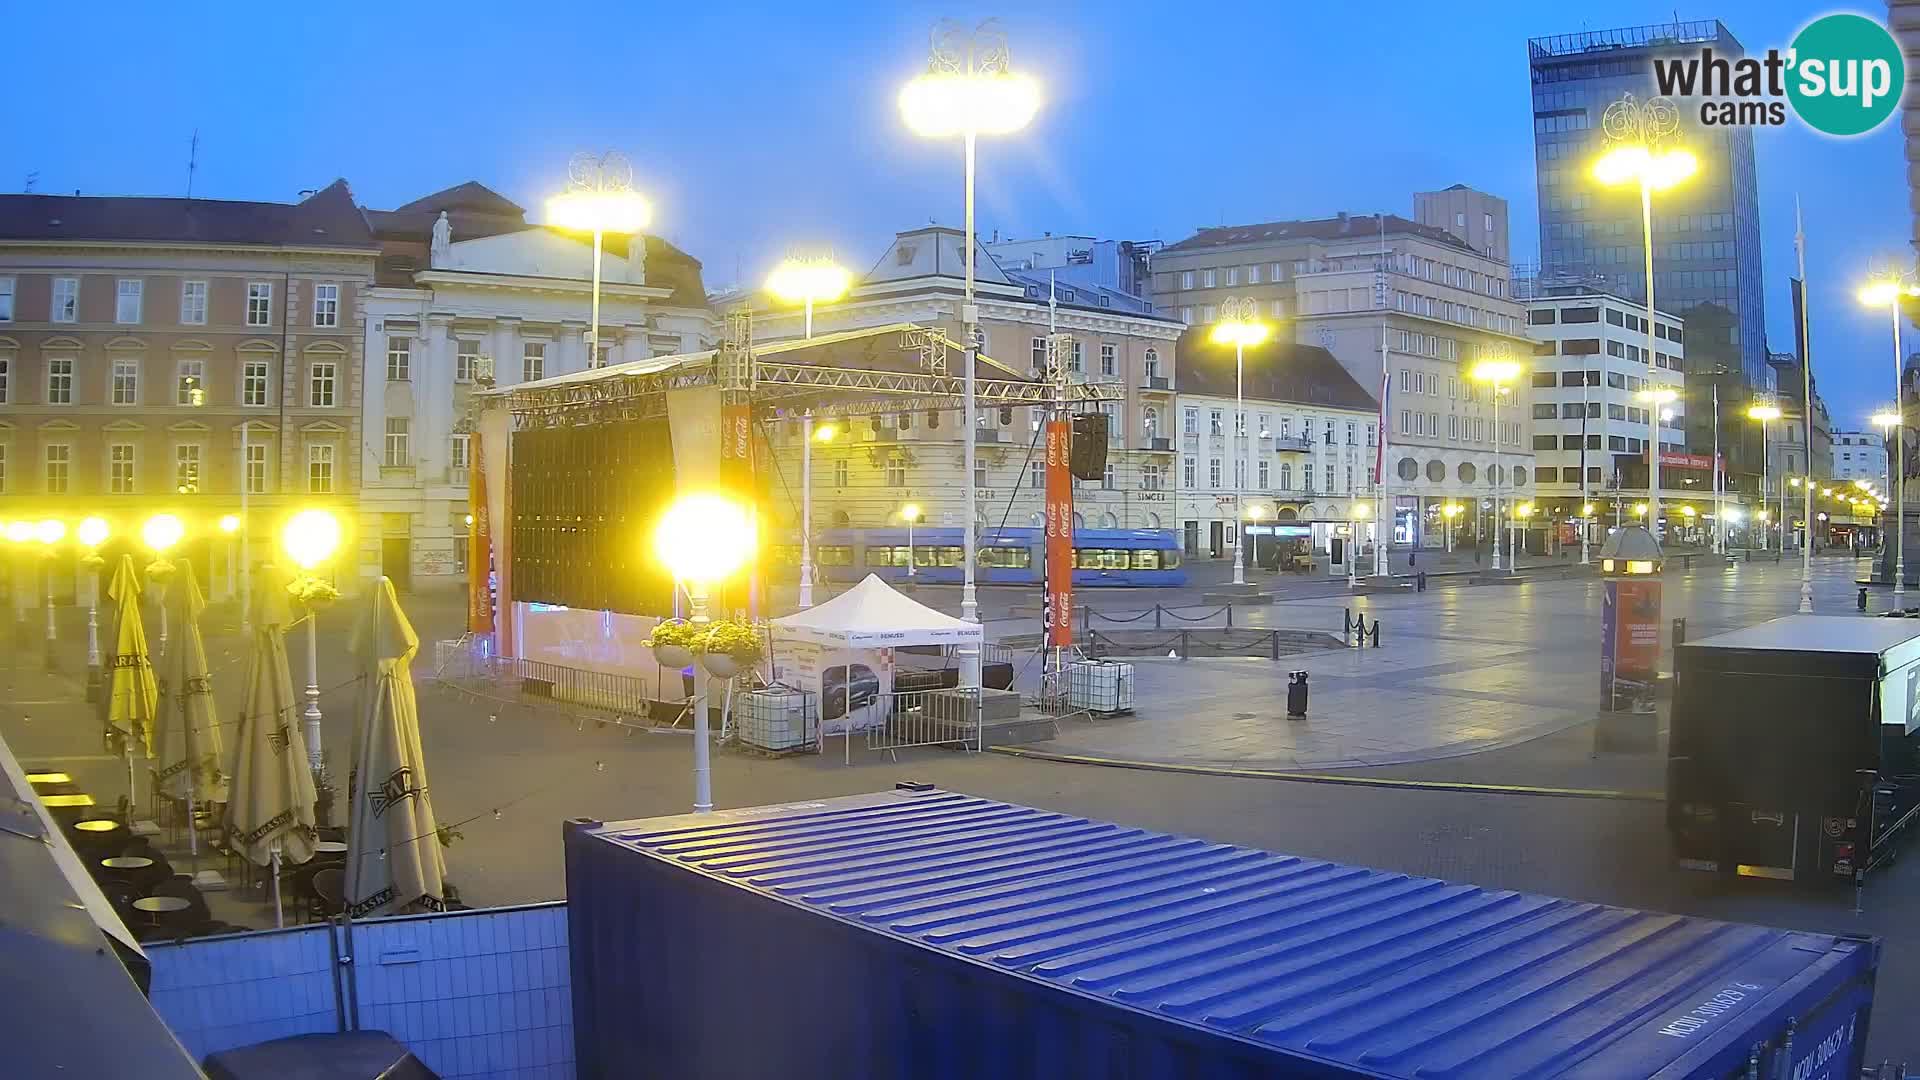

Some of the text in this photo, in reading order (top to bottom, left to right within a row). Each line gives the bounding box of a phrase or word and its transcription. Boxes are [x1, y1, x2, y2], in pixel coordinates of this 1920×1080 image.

[960, 489, 996, 499] SGER
[1137, 492, 1166, 501] SINGER
[1658, 1015, 1708, 1038] MCDU
[1691, 989, 1746, 1017] 300629
